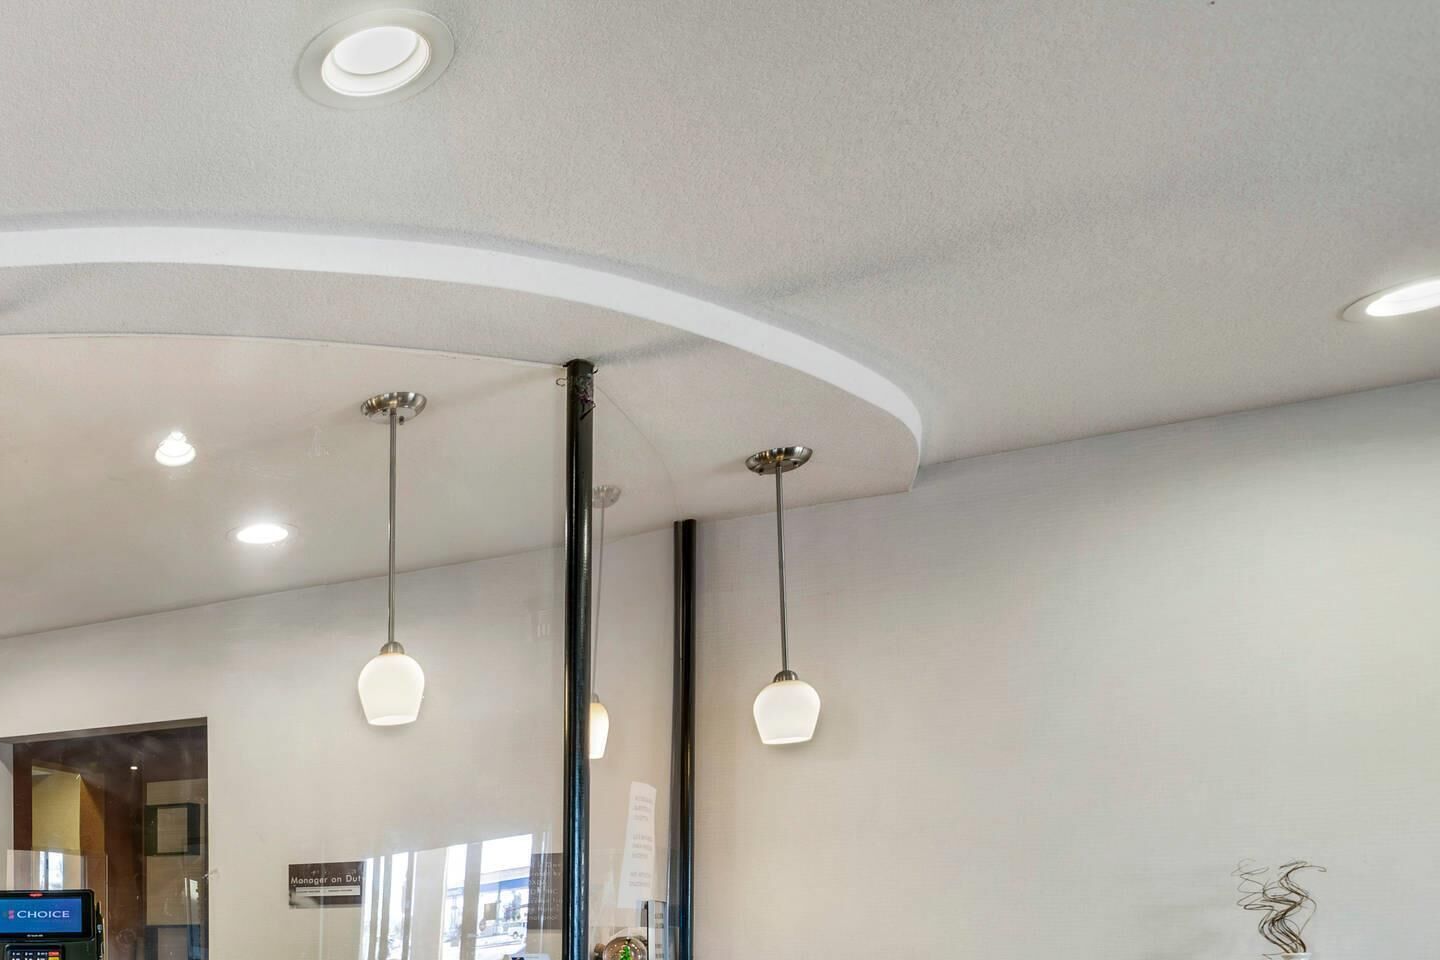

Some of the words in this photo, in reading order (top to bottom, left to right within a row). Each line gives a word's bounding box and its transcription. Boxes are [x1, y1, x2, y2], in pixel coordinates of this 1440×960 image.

[291, 876, 328, 885] Manager
[346, 874, 362, 883] Dut
[16, 910, 70, 919] CHOICE
